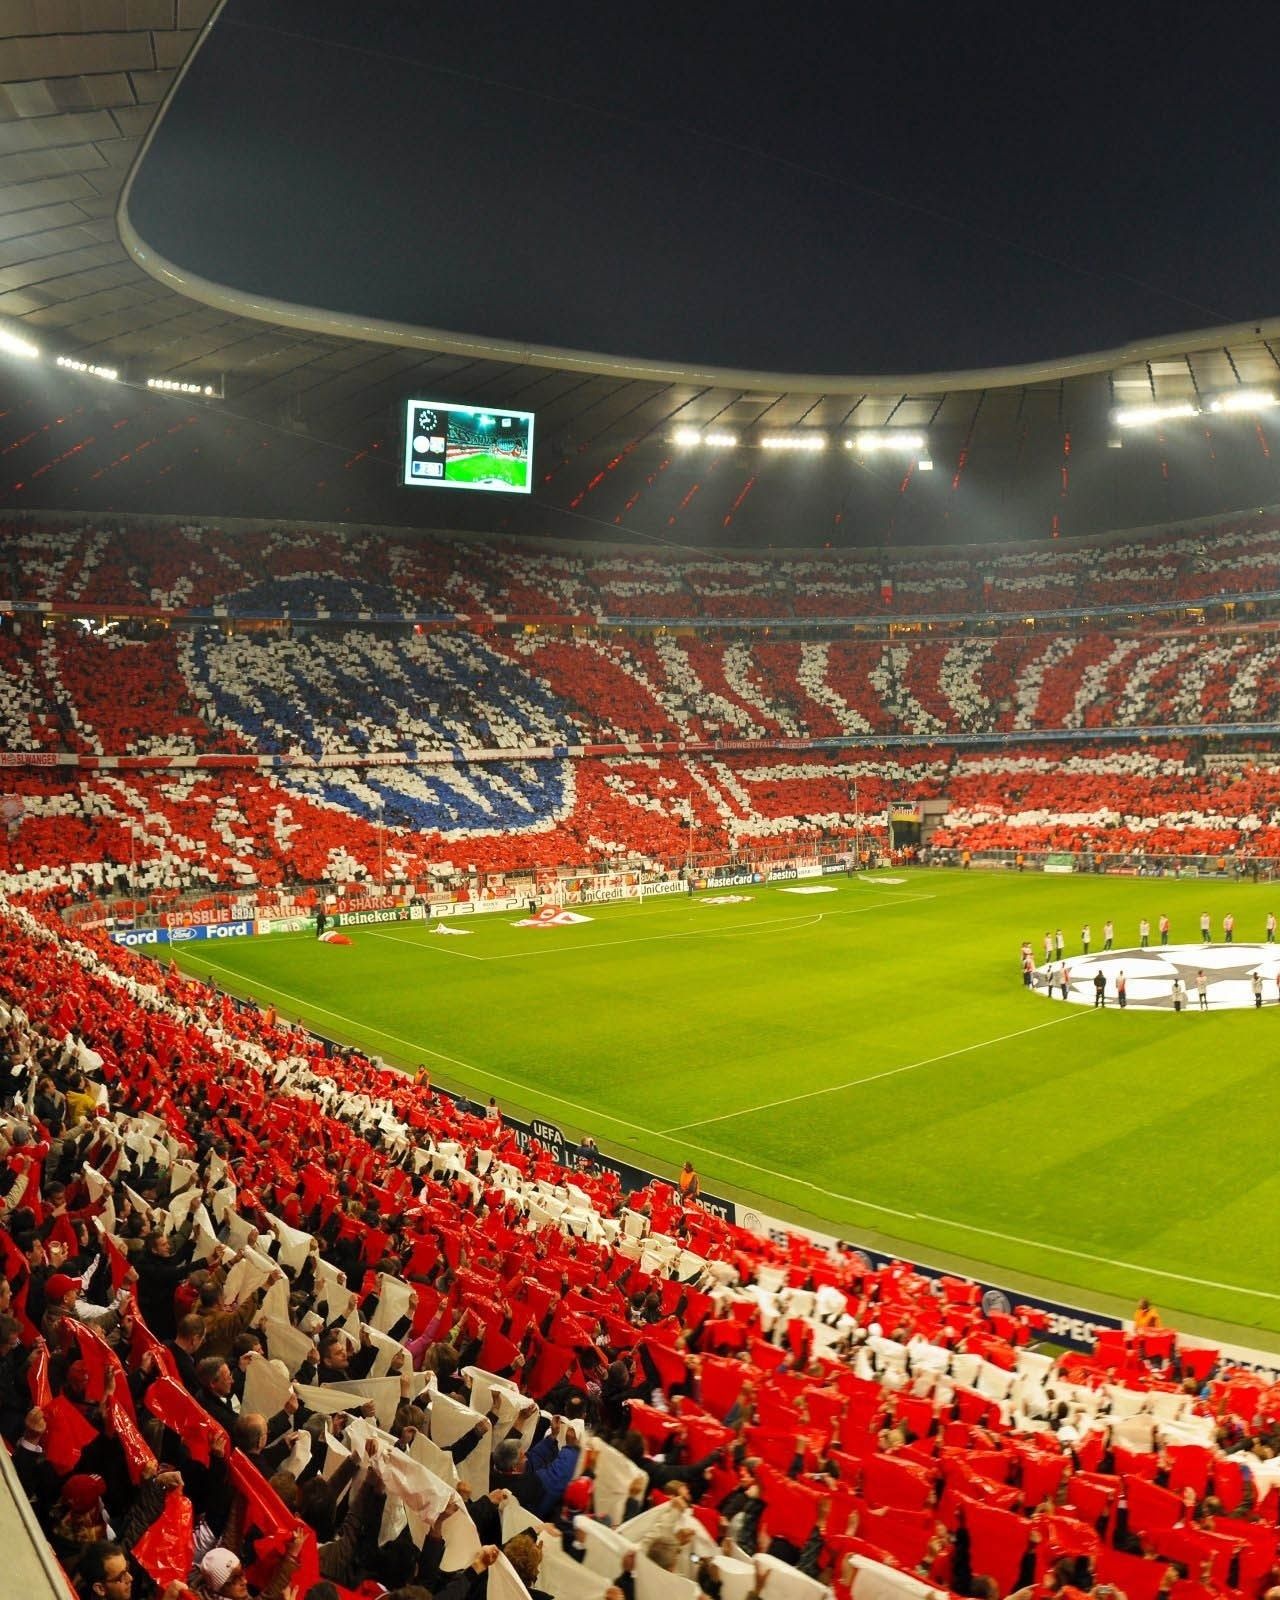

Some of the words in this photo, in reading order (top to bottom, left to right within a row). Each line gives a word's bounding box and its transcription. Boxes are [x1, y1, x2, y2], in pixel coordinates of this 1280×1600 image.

[707, 874, 752, 888] MasterCard
[350, 896, 394, 911] SHARKS
[339, 906, 397, 926] Heineken
[115, 929, 157, 946] Ford
[206, 923, 247, 938] Ford
[533, 1122, 563, 1146] UEFA
